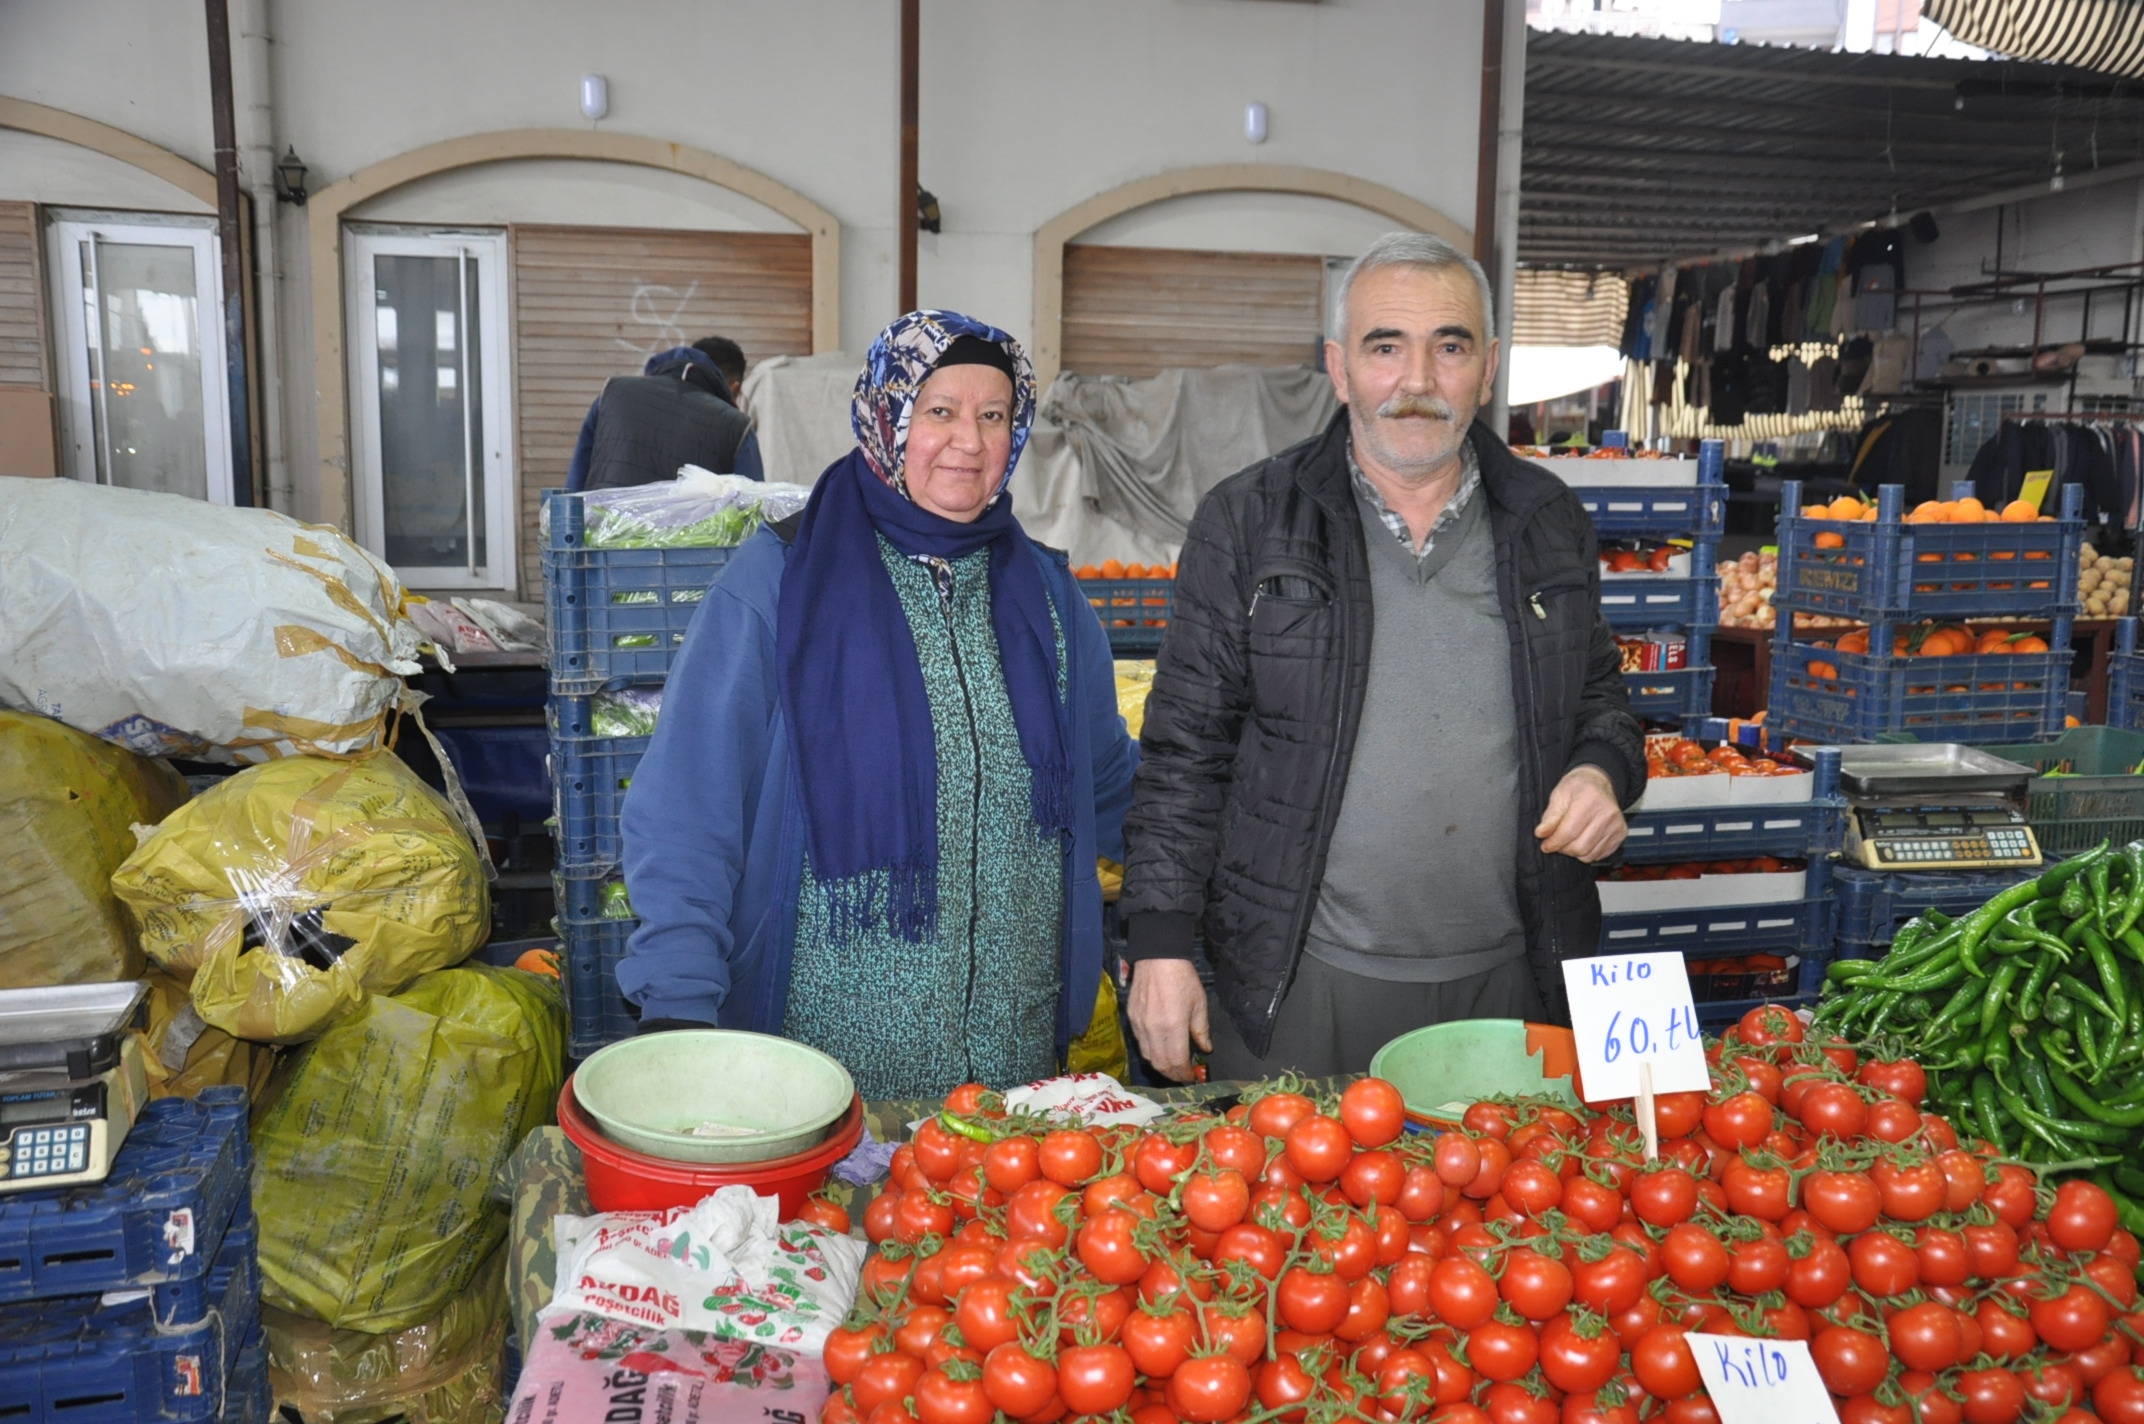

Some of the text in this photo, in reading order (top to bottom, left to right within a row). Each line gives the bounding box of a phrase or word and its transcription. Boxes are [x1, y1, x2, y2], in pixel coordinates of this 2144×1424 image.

[1590, 961, 1652, 986] Kilo
[1714, 1340, 1788, 1387] Kilo
[602, 1369, 649, 1424] DAĞ
